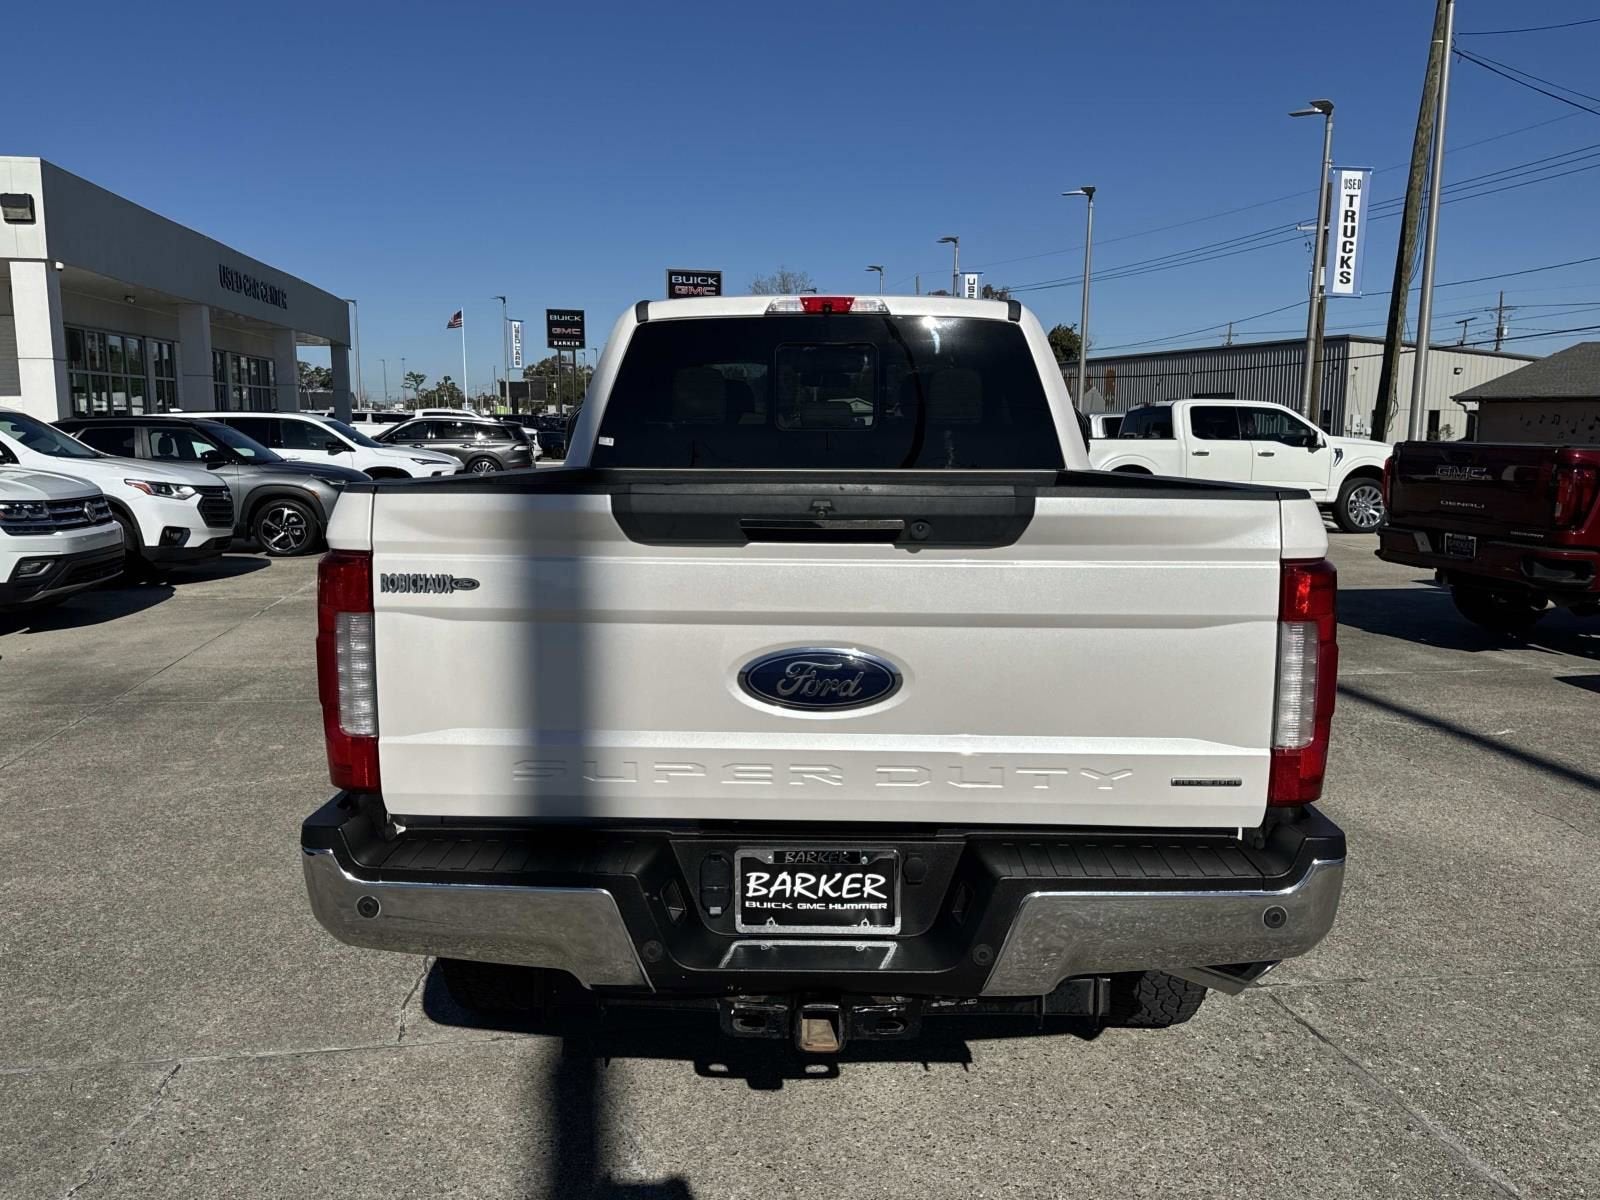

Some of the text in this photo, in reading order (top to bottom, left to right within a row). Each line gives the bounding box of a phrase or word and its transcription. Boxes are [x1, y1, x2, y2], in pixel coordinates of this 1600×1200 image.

[1344, 179, 1362, 190] USED
[1338, 194, 1359, 284] TRUCKS
[218, 264, 242, 293] USED
[671, 275, 718, 285] BUICK
[674, 285, 716, 296] GMC
[551, 327, 581, 335] GMC
[1436, 465, 1488, 480] GMC
[380, 573, 454, 594] ROBICHAUX
[776, 660, 864, 698] Ford
[513, 759, 1133, 790] SUPER DUTY
[784, 851, 850, 864] BARKER
[745, 871, 888, 899] BARKER
[745, 901, 794, 909] BUICK
[797, 902, 826, 910] GMC
